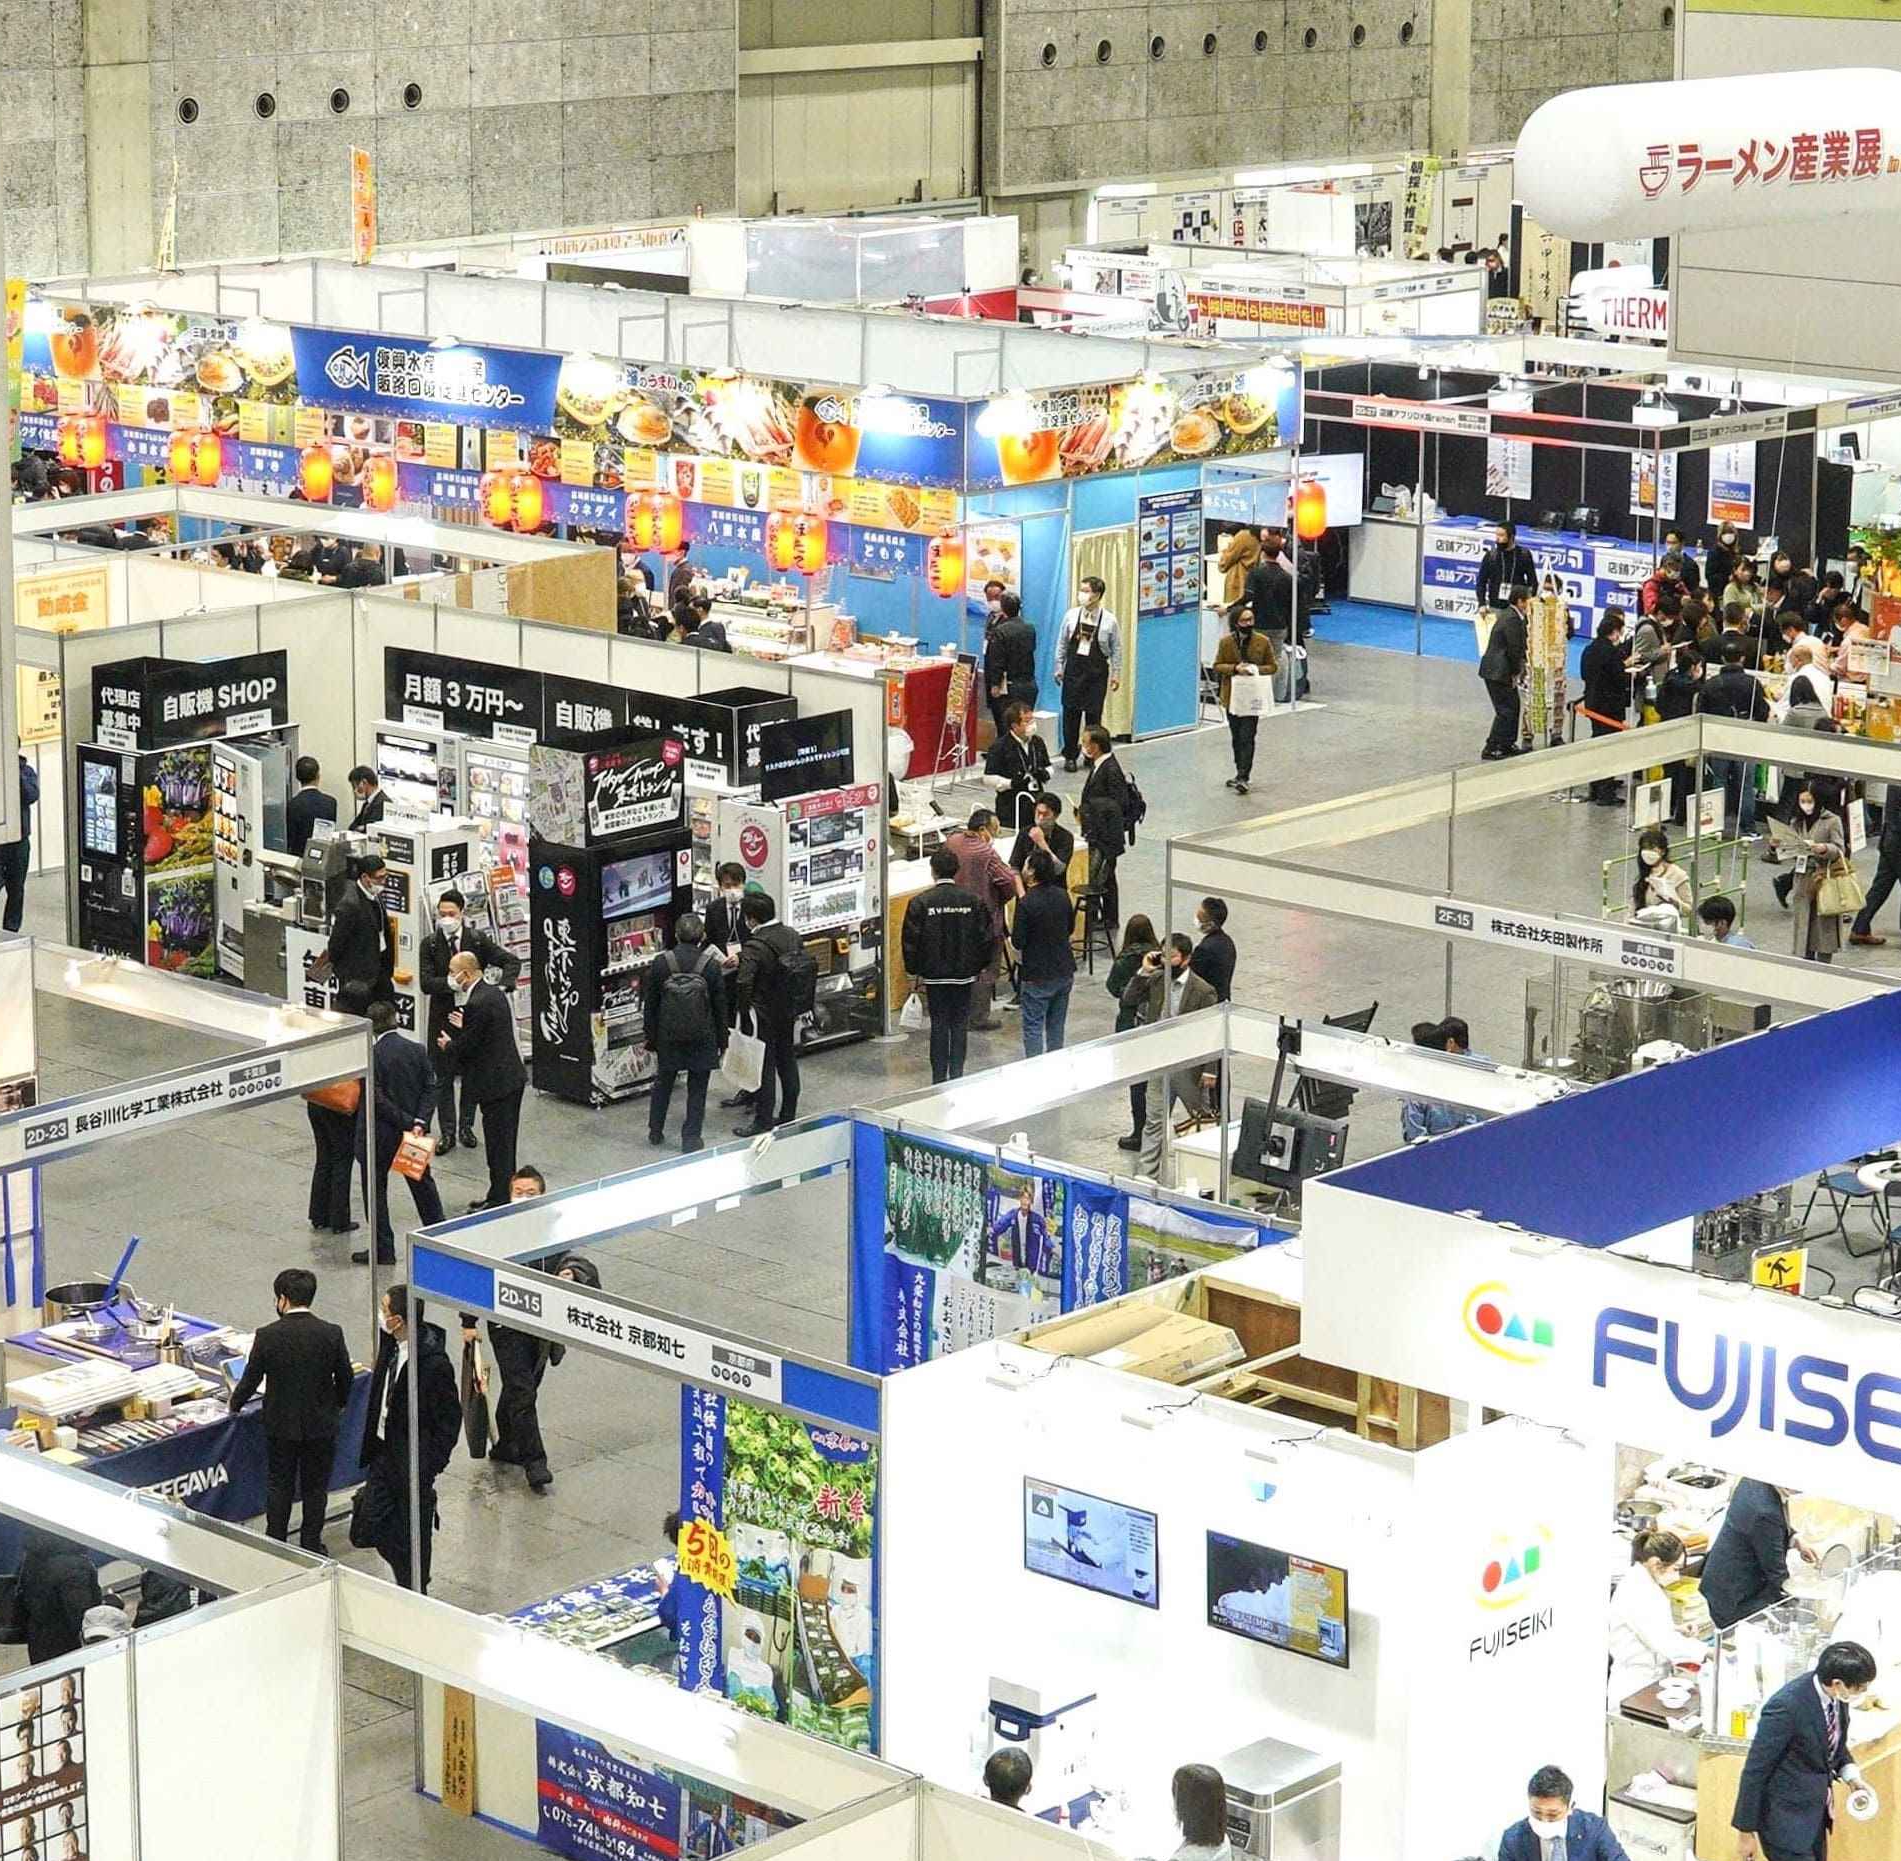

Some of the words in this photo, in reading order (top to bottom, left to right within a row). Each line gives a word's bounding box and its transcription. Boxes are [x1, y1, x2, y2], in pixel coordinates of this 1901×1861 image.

[1677, 128, 1882, 193] ラーメン産業展
[569, 502, 616, 519] カネダイ
[865, 544, 905, 562] ともや
[101, 686, 140, 709] 代理店
[101, 709, 141, 732] 募集中
[163, 688, 214, 721] 自販機
[219, 677, 277, 706] SHOP
[555, 700, 612, 731] 自販機
[1438, 908, 1470, 929] 2F-15
[1490, 917, 1603, 956] 株式会社矢田製作所
[26, 1122, 67, 1147] 2D-23
[75, 1080, 223, 1134] 長谷川化学工業株式会社
[500, 1285, 542, 1315] 2D-15
[566, 1305, 624, 1343] 株式会社
[627, 1326, 687, 1363] 京都知七
[1468, 1607, 1555, 1664] FUJISEIKI
[585, 1767, 668, 1821] 京都知七
